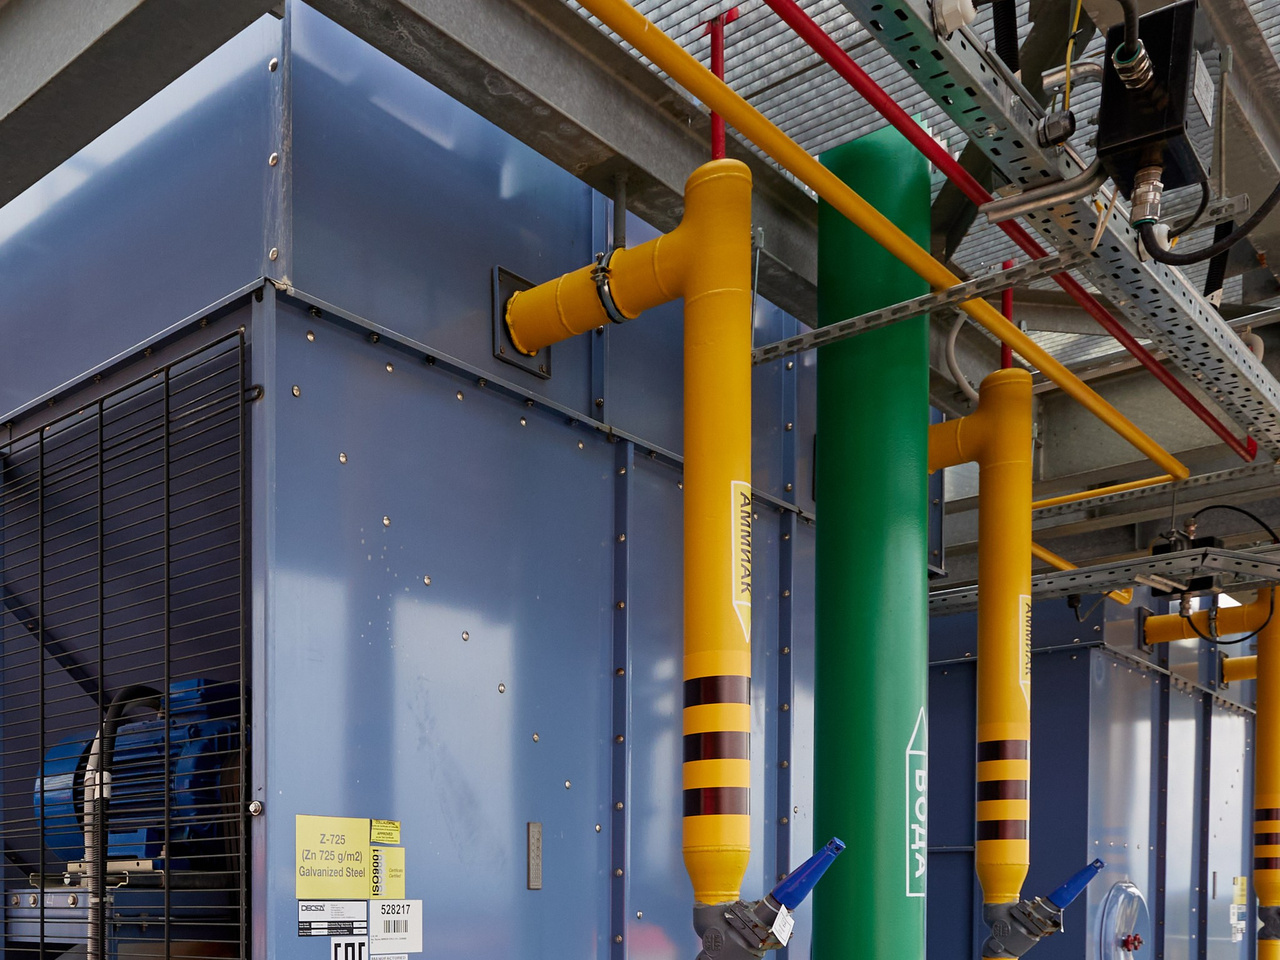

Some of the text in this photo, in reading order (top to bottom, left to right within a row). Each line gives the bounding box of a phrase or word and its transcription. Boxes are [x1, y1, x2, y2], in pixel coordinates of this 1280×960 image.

[740, 492, 751, 595] АММИАК
[911, 769, 927, 878] ВОДА
[320, 833, 346, 845] Z-725
[302, 849, 363, 864] (Zn 725 g/m2)
[299, 865, 366, 878] Galvanized Steel
[372, 849, 380, 896] ISO9001
[381, 904, 411, 915] 528217
